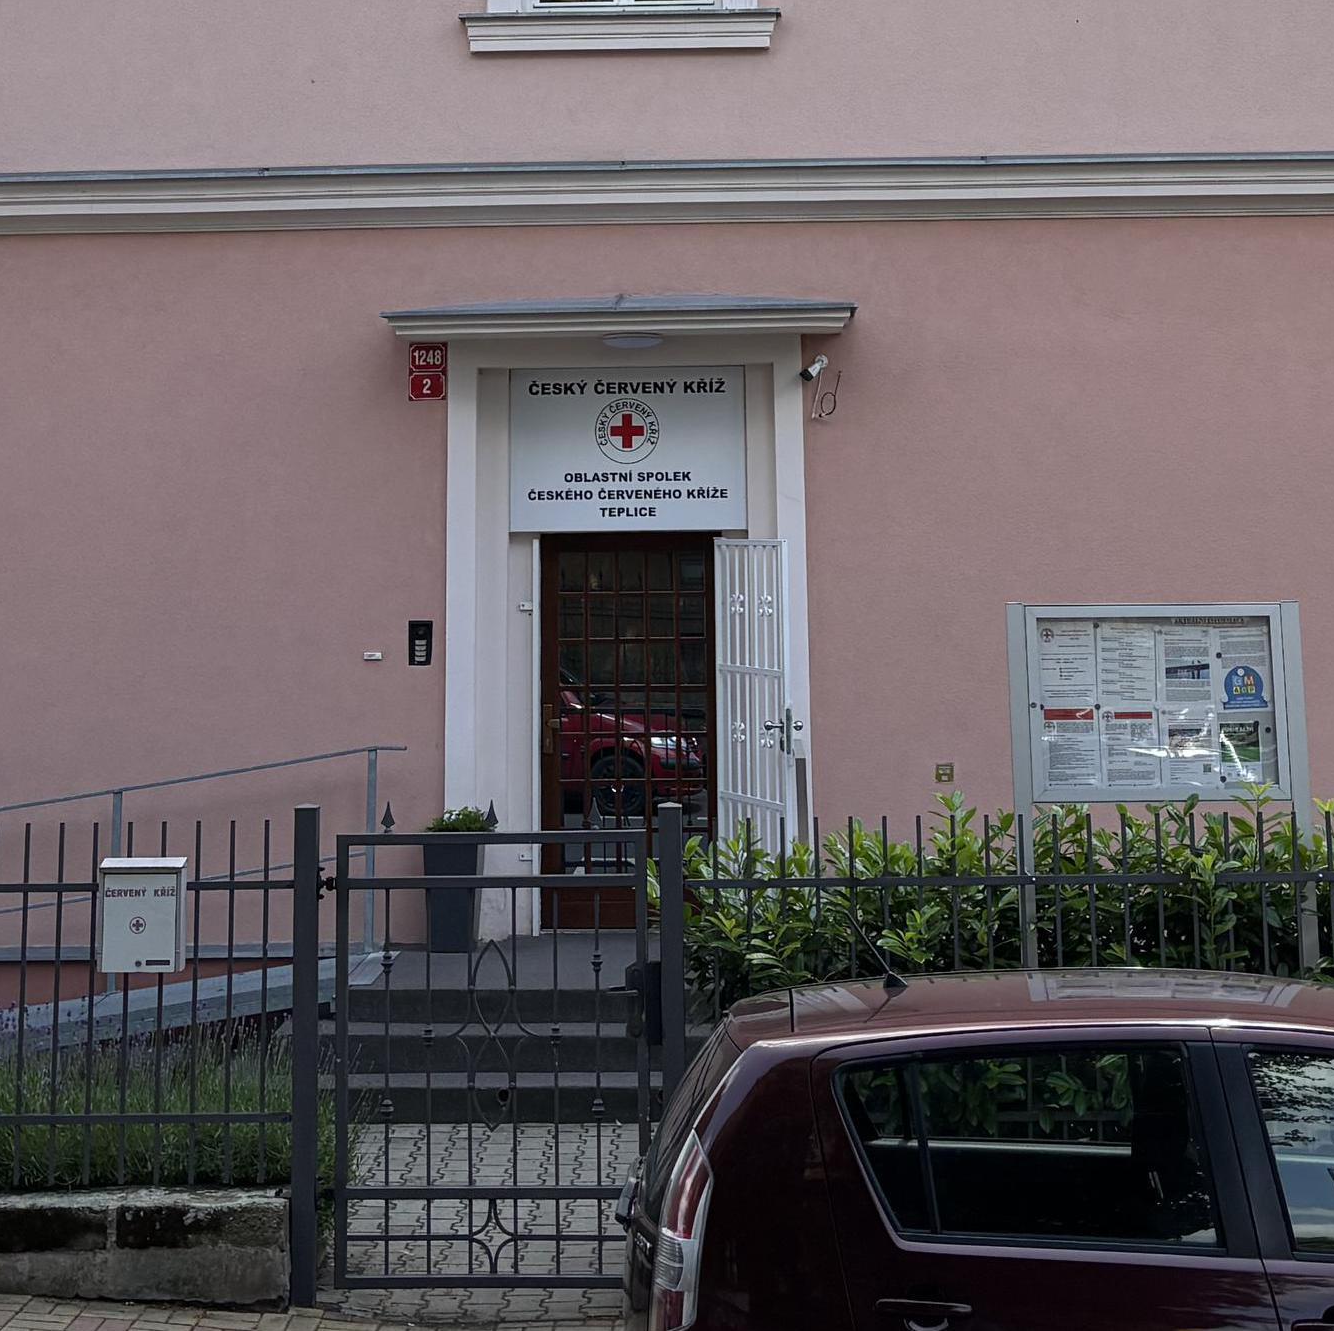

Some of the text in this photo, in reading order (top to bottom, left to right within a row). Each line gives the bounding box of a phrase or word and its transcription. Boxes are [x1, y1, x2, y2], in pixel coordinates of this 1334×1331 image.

[413, 349, 442, 366] 1248
[422, 378, 432, 394] 2
[528, 378, 726, 395] ČESKÝ ČERVENÝ KŘÍŽ
[564, 470, 692, 483] OBLASTNÍ SPOLEK
[528, 487, 728, 501] ČESKÉHO ČERVENÉHO KŘÍŽE
[599, 507, 657, 518] TEPLICE
[105, 886, 176, 898] ČERVENÝ KŘÍŽ
